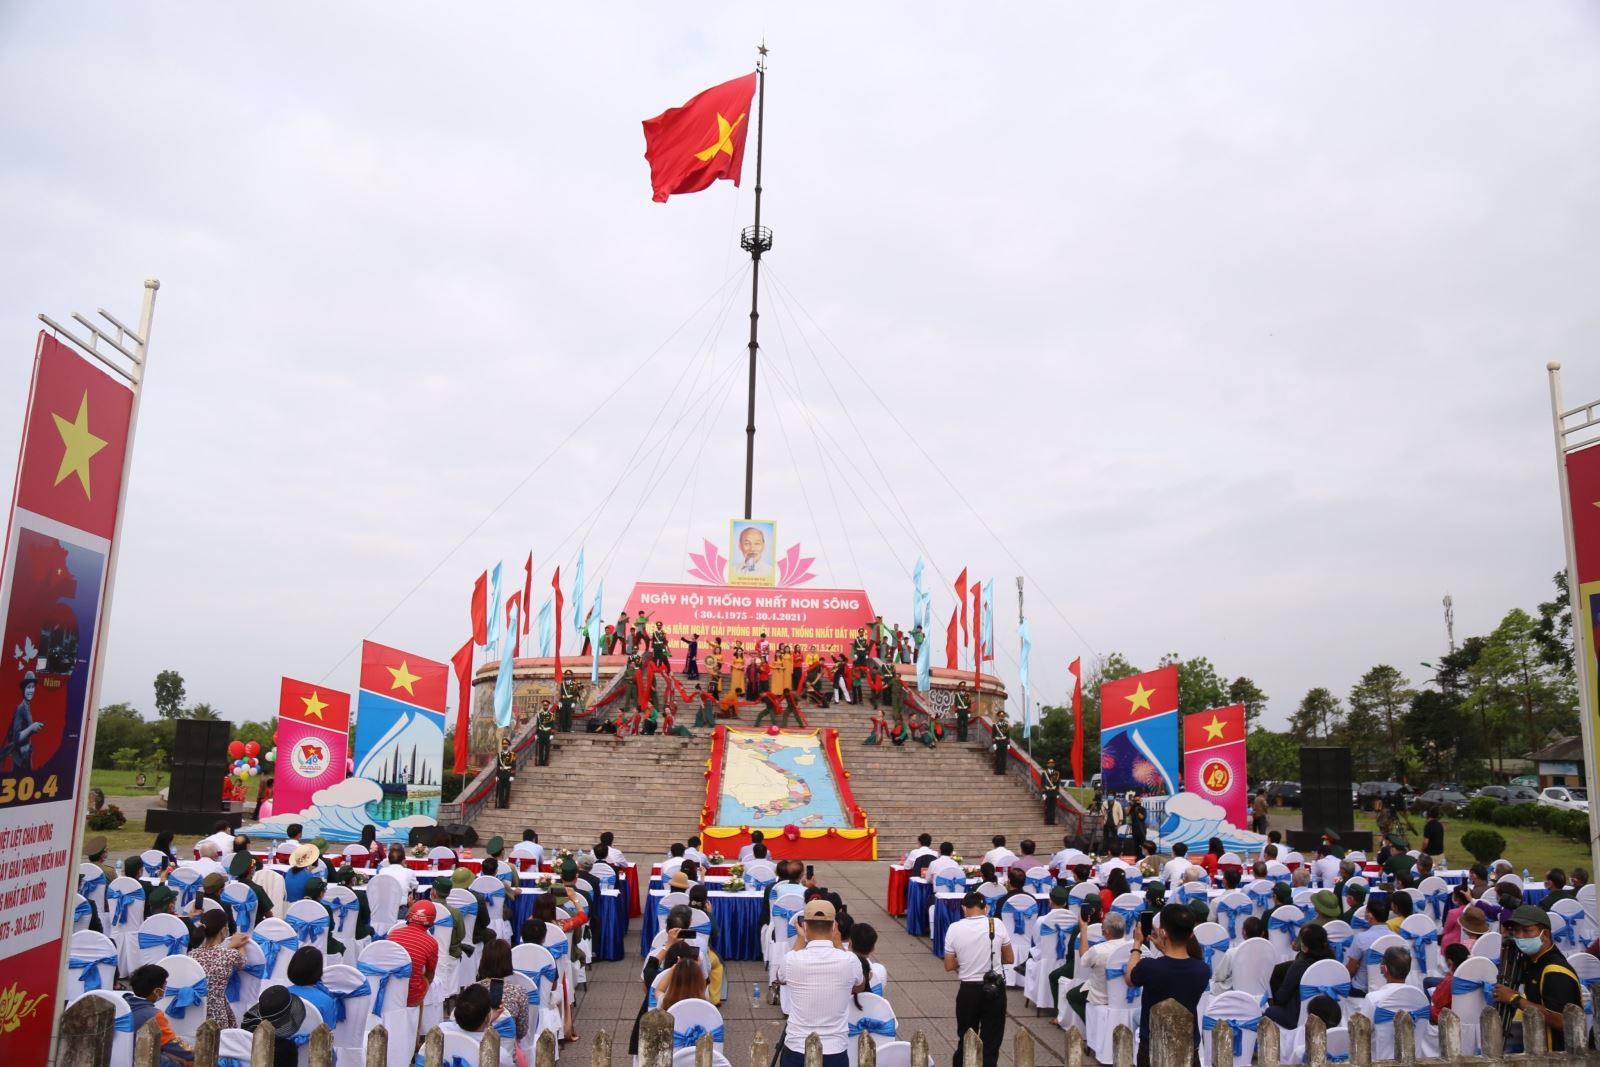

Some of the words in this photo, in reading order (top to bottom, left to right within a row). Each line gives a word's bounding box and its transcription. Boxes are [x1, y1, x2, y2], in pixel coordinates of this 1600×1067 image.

[641, 592, 676, 604] NGÀY
[681, 592, 704, 608] HỘI
[707, 593, 752, 607] THỐNG
[756, 594, 788, 608] NHẤT
[791, 598, 820, 608] NON
[824, 597, 860, 610] SÔNG
[0, 774, 58, 804] 30.4
